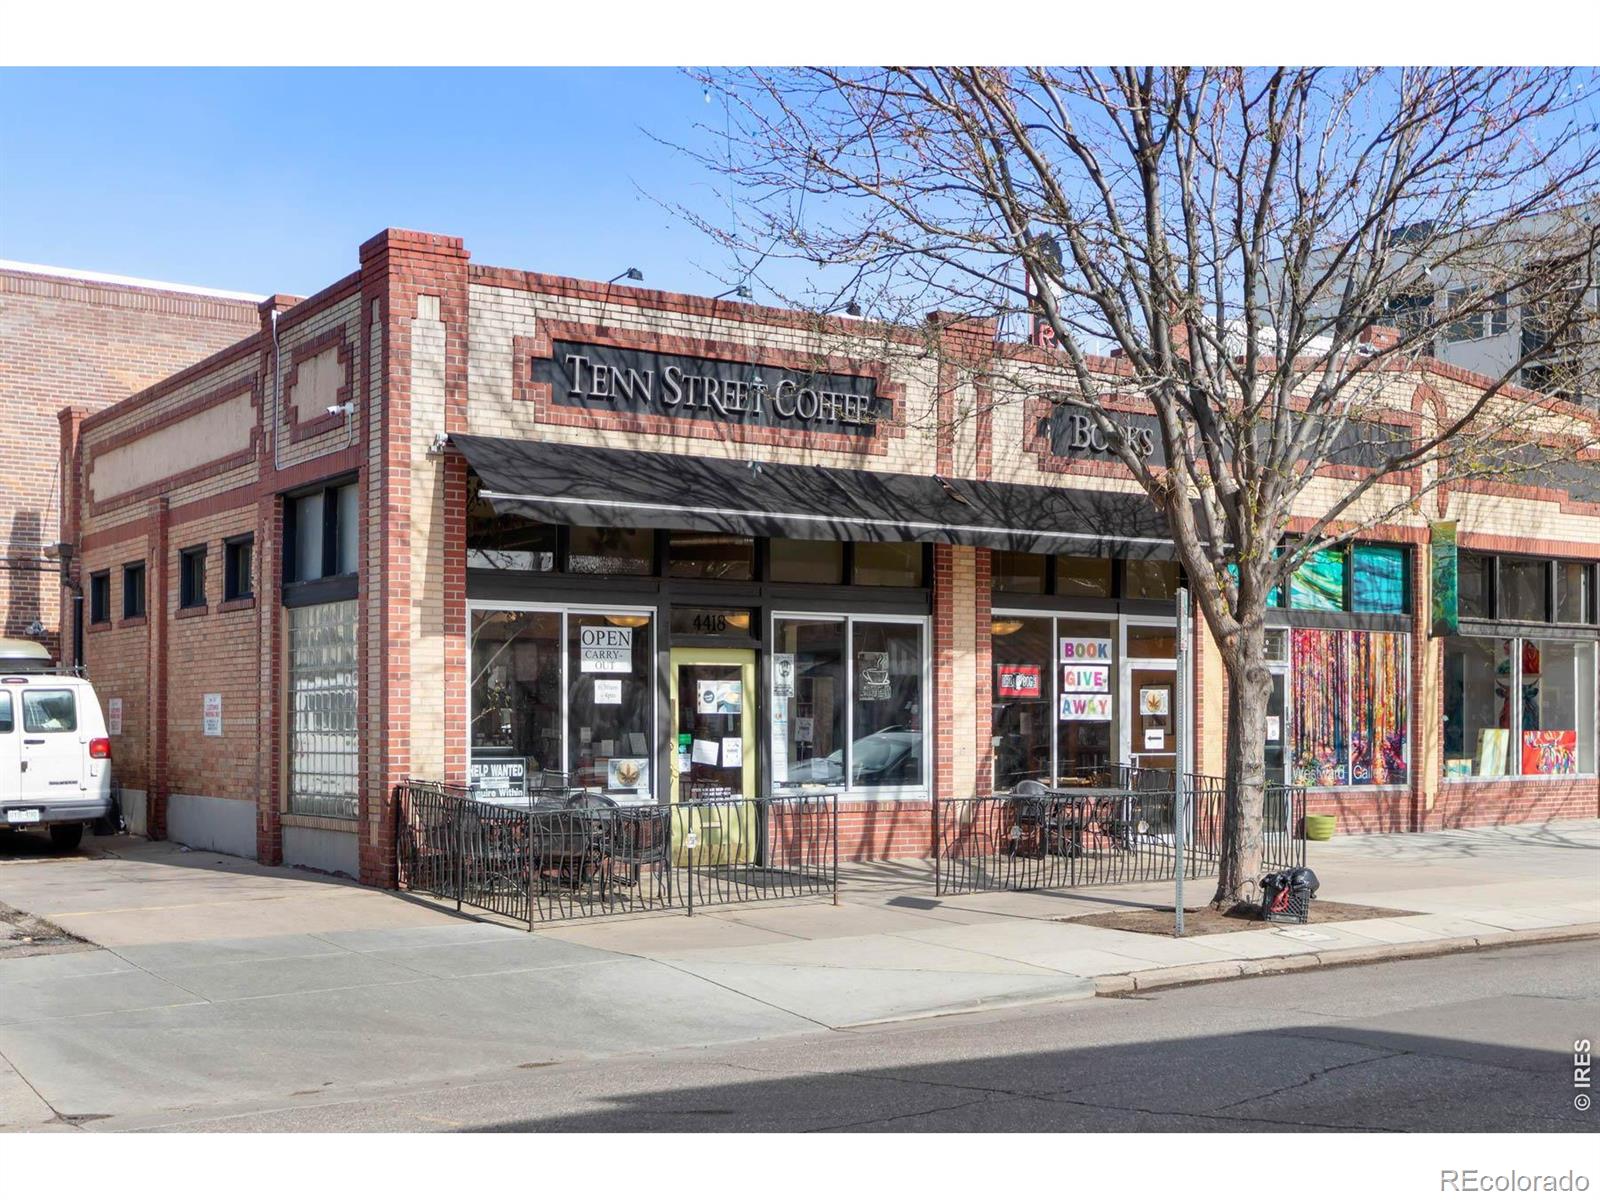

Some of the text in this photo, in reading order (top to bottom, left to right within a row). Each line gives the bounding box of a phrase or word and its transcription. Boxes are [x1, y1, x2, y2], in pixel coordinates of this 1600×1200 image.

[564, 353, 871, 425] TENN STREET COFFEE
[1070, 414, 1154, 456] BOKS
[693, 613, 726, 633] 4418
[582, 629, 632, 646] OPEN
[1064, 642, 1108, 658] BOOK
[595, 661, 615, 670] OUT
[1062, 699, 1107, 715] AWAY
[490, 764, 524, 777] WANTED
[498, 787, 524, 798] Within
